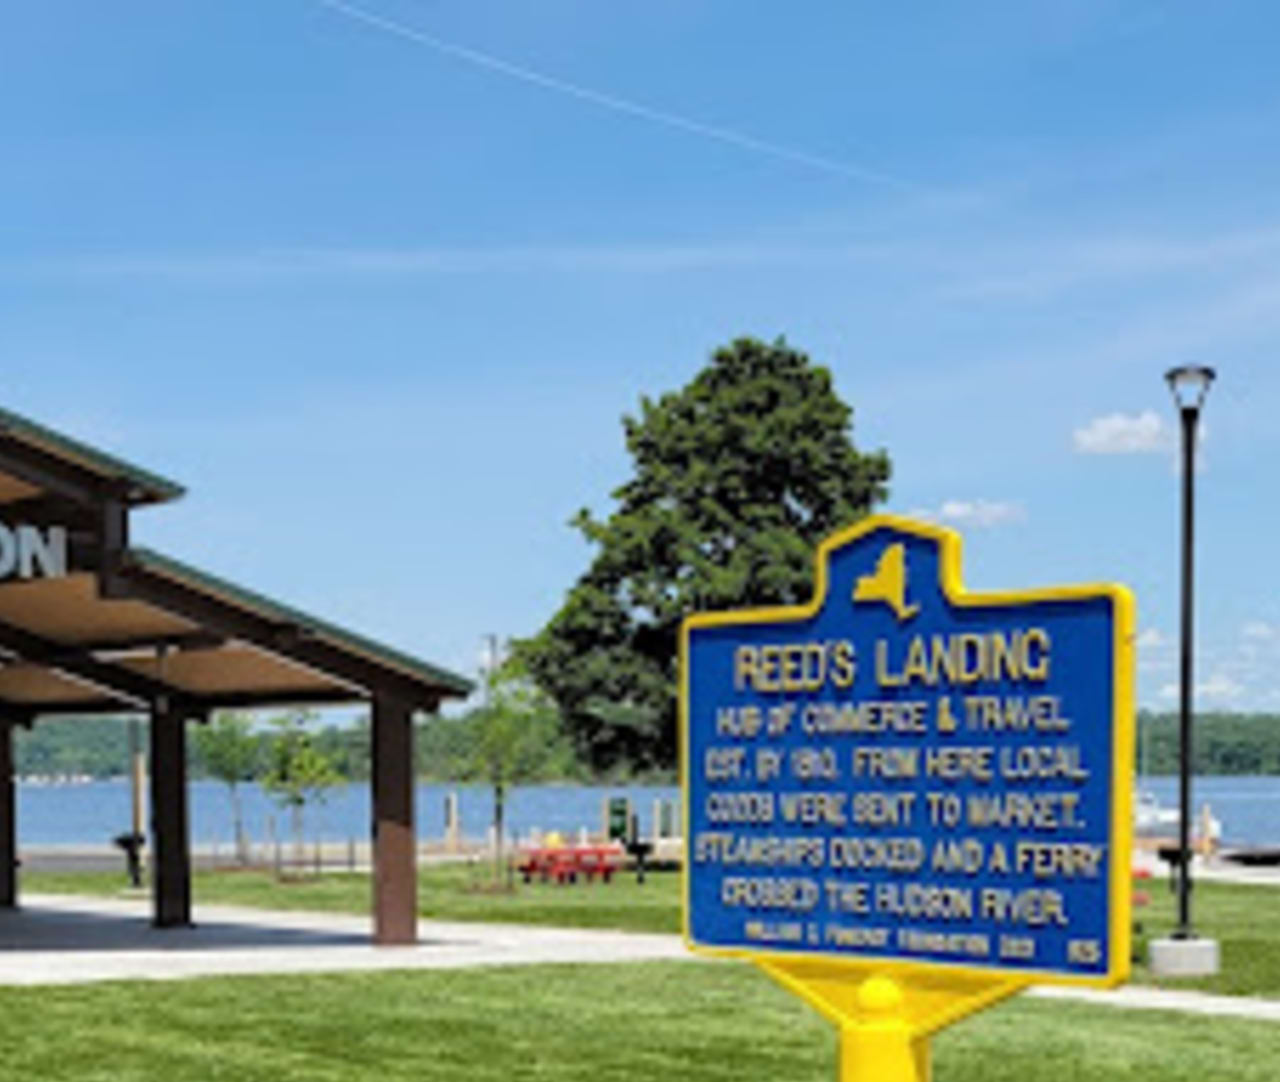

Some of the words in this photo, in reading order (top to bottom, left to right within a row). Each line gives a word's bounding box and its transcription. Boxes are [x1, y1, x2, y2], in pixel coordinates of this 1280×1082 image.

[733, 638, 858, 692] REED'S
[876, 627, 1051, 686] LANDING
[716, 706, 762, 736] HUB
[801, 700, 928, 733] COMMERCE
[937, 697, 956, 732] &
[852, 747, 919, 778] FROM
[926, 746, 994, 780] HERE
[1000, 745, 1091, 779] LOCAL
[779, 792, 847, 824] WERE
[852, 792, 916, 826] SENT
[926, 792, 961, 826] TO
[967, 792, 1086, 829] MARKET.
[830, 837, 923, 872] DOCKED
[932, 838, 984, 873] AND
[988, 841, 1010, 874] A
[1016, 841, 1102, 878] FERRY
[824, 880, 869, 913] THE
[876, 882, 973, 920] HUDSON
